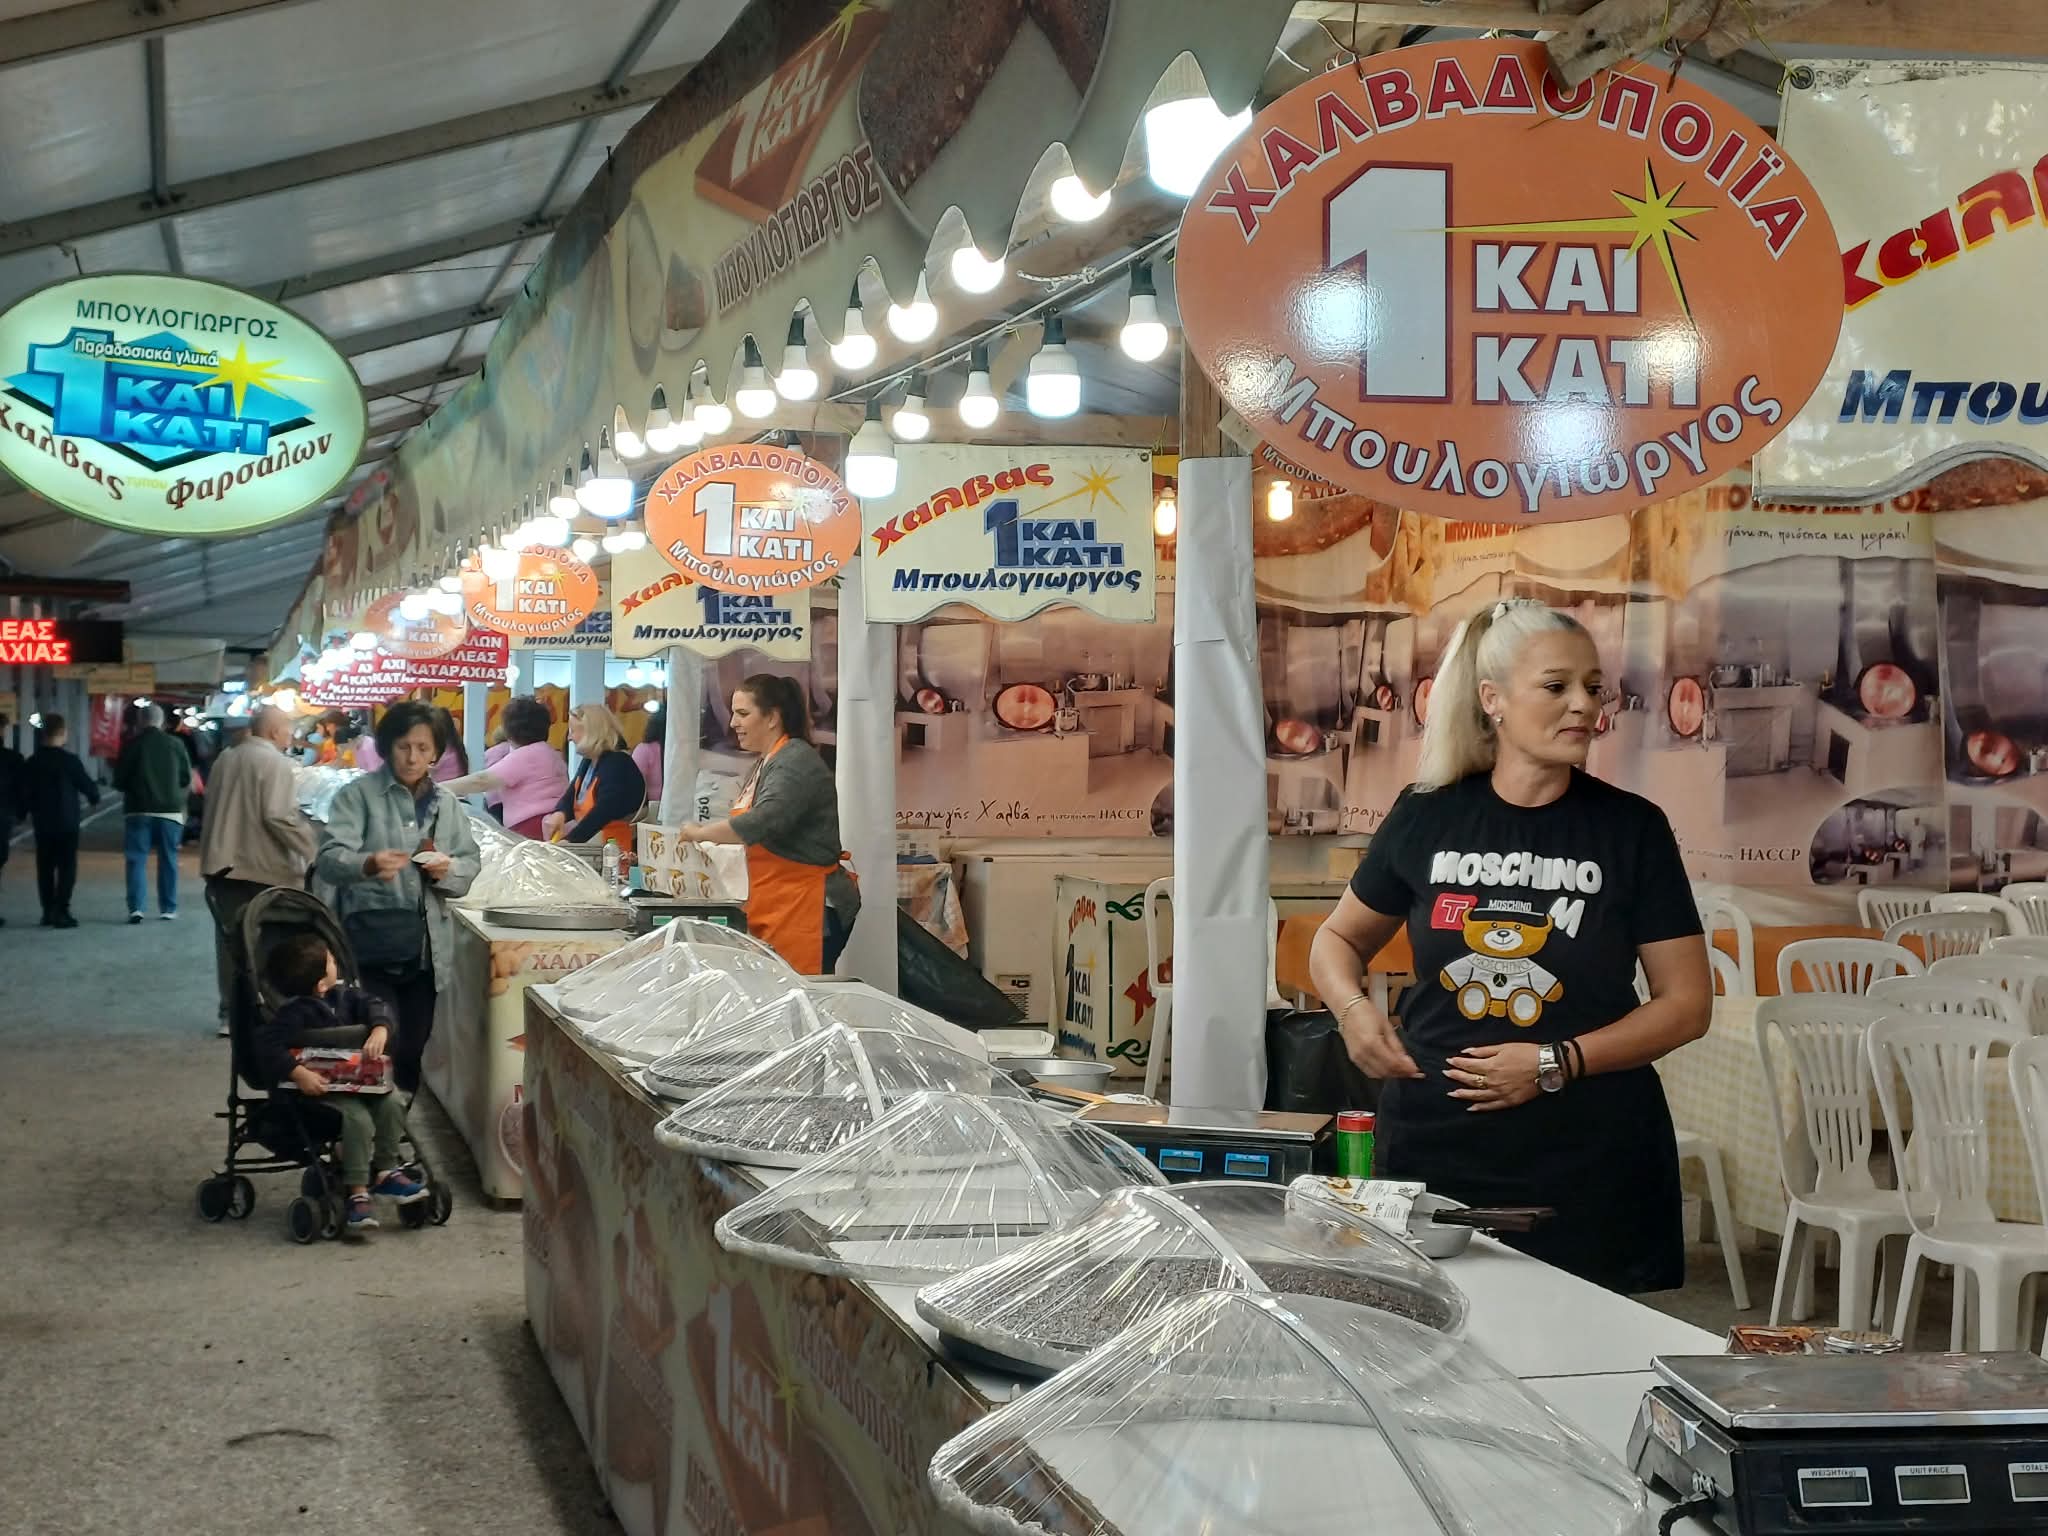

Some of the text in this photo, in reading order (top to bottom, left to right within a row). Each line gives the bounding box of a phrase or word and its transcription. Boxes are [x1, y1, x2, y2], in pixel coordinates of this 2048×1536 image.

[764, 49, 826, 118] ΚΑΙ
[752, 76, 829, 165] ΚΑΤΙ
[713, 145, 881, 312] ΜΠΟΥΛΟΓΙΩΡΓΟΣ
[1322, 160, 1452, 403] 1
[1472, 239, 1641, 316] ΚΑΙ
[77, 299, 279, 339] ΜΠΟΥΛΟΓΙΩΡΓΟΣ
[74, 337, 219, 367] Παραδοσιακά γλυκά
[27, 327, 114, 437] 1
[1472, 332, 1699, 408] ΚΑΤΙ
[115, 376, 226, 415] ΚΑΙ
[113, 410, 264, 452] ΚΑΤΙ
[657, 450, 850, 517] ΧΑΛΒΑΔΟΠΟΙΪΑ
[693, 481, 735, 556] 1
[740, 506, 796, 532] ΚΑΙ
[1022, 519, 1097, 541] ΚΑΙ
[984, 498, 1020, 568] 1
[739, 535, 814, 562] ΚΑΤΙ
[1022, 545, 1125, 567] ΚΑΤΙ
[518, 578, 555, 595] ΚΑΙ
[892, 568, 1142, 595] Μπουλογιωργος
[518, 598, 568, 614] ΚΑΤΙ
[723, 595, 774, 608] ΚΑΙ
[0, 621, 54, 640] ΕΑΣ
[723, 611, 792, 625] ΚΑΤΙ
[634, 625, 804, 646] Μπουλογιωργος
[406, 662, 505, 680] ΚΑΤΑΡΑΧΙΑΣ
[976, 800, 1029, 826] Χαλβά
[1099, 809, 1143, 820] HACCP
[1740, 847, 1800, 861] HACCP
[1430, 850, 1602, 894] MOSCHINO
[1488, 899, 1533, 912] MOSCHINO
[1075, 969, 1091, 997] ΚΑΙ
[1075, 1001, 1094, 1030] ΚΑΤΙ
